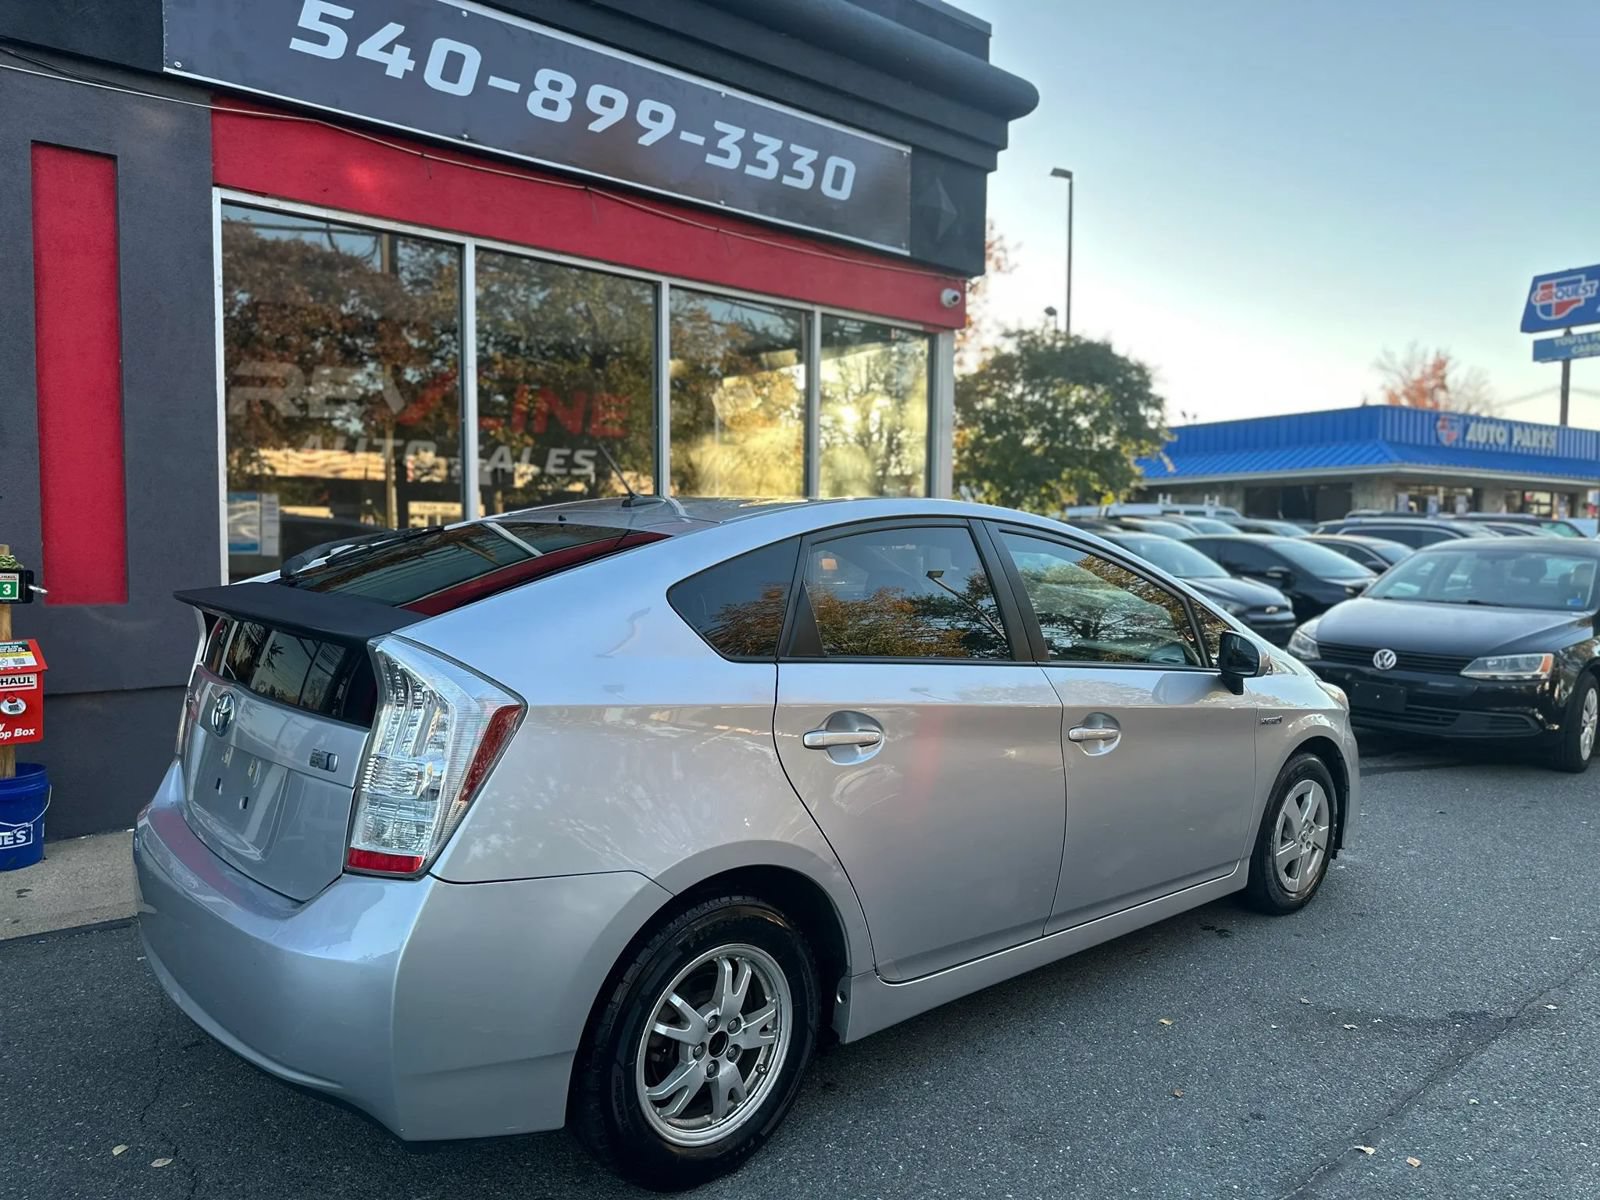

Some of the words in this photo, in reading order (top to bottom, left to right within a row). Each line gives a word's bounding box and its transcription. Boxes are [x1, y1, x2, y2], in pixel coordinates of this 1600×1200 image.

[289, 0, 856, 201] 540-899-3330
[1466, 422, 1506, 445] AUTO
[1512, 427, 1556, 449] PARTS
[302, 434, 438, 468] AUTO
[478, 443, 597, 475] ALES
[14, 727, 36, 737] Box
